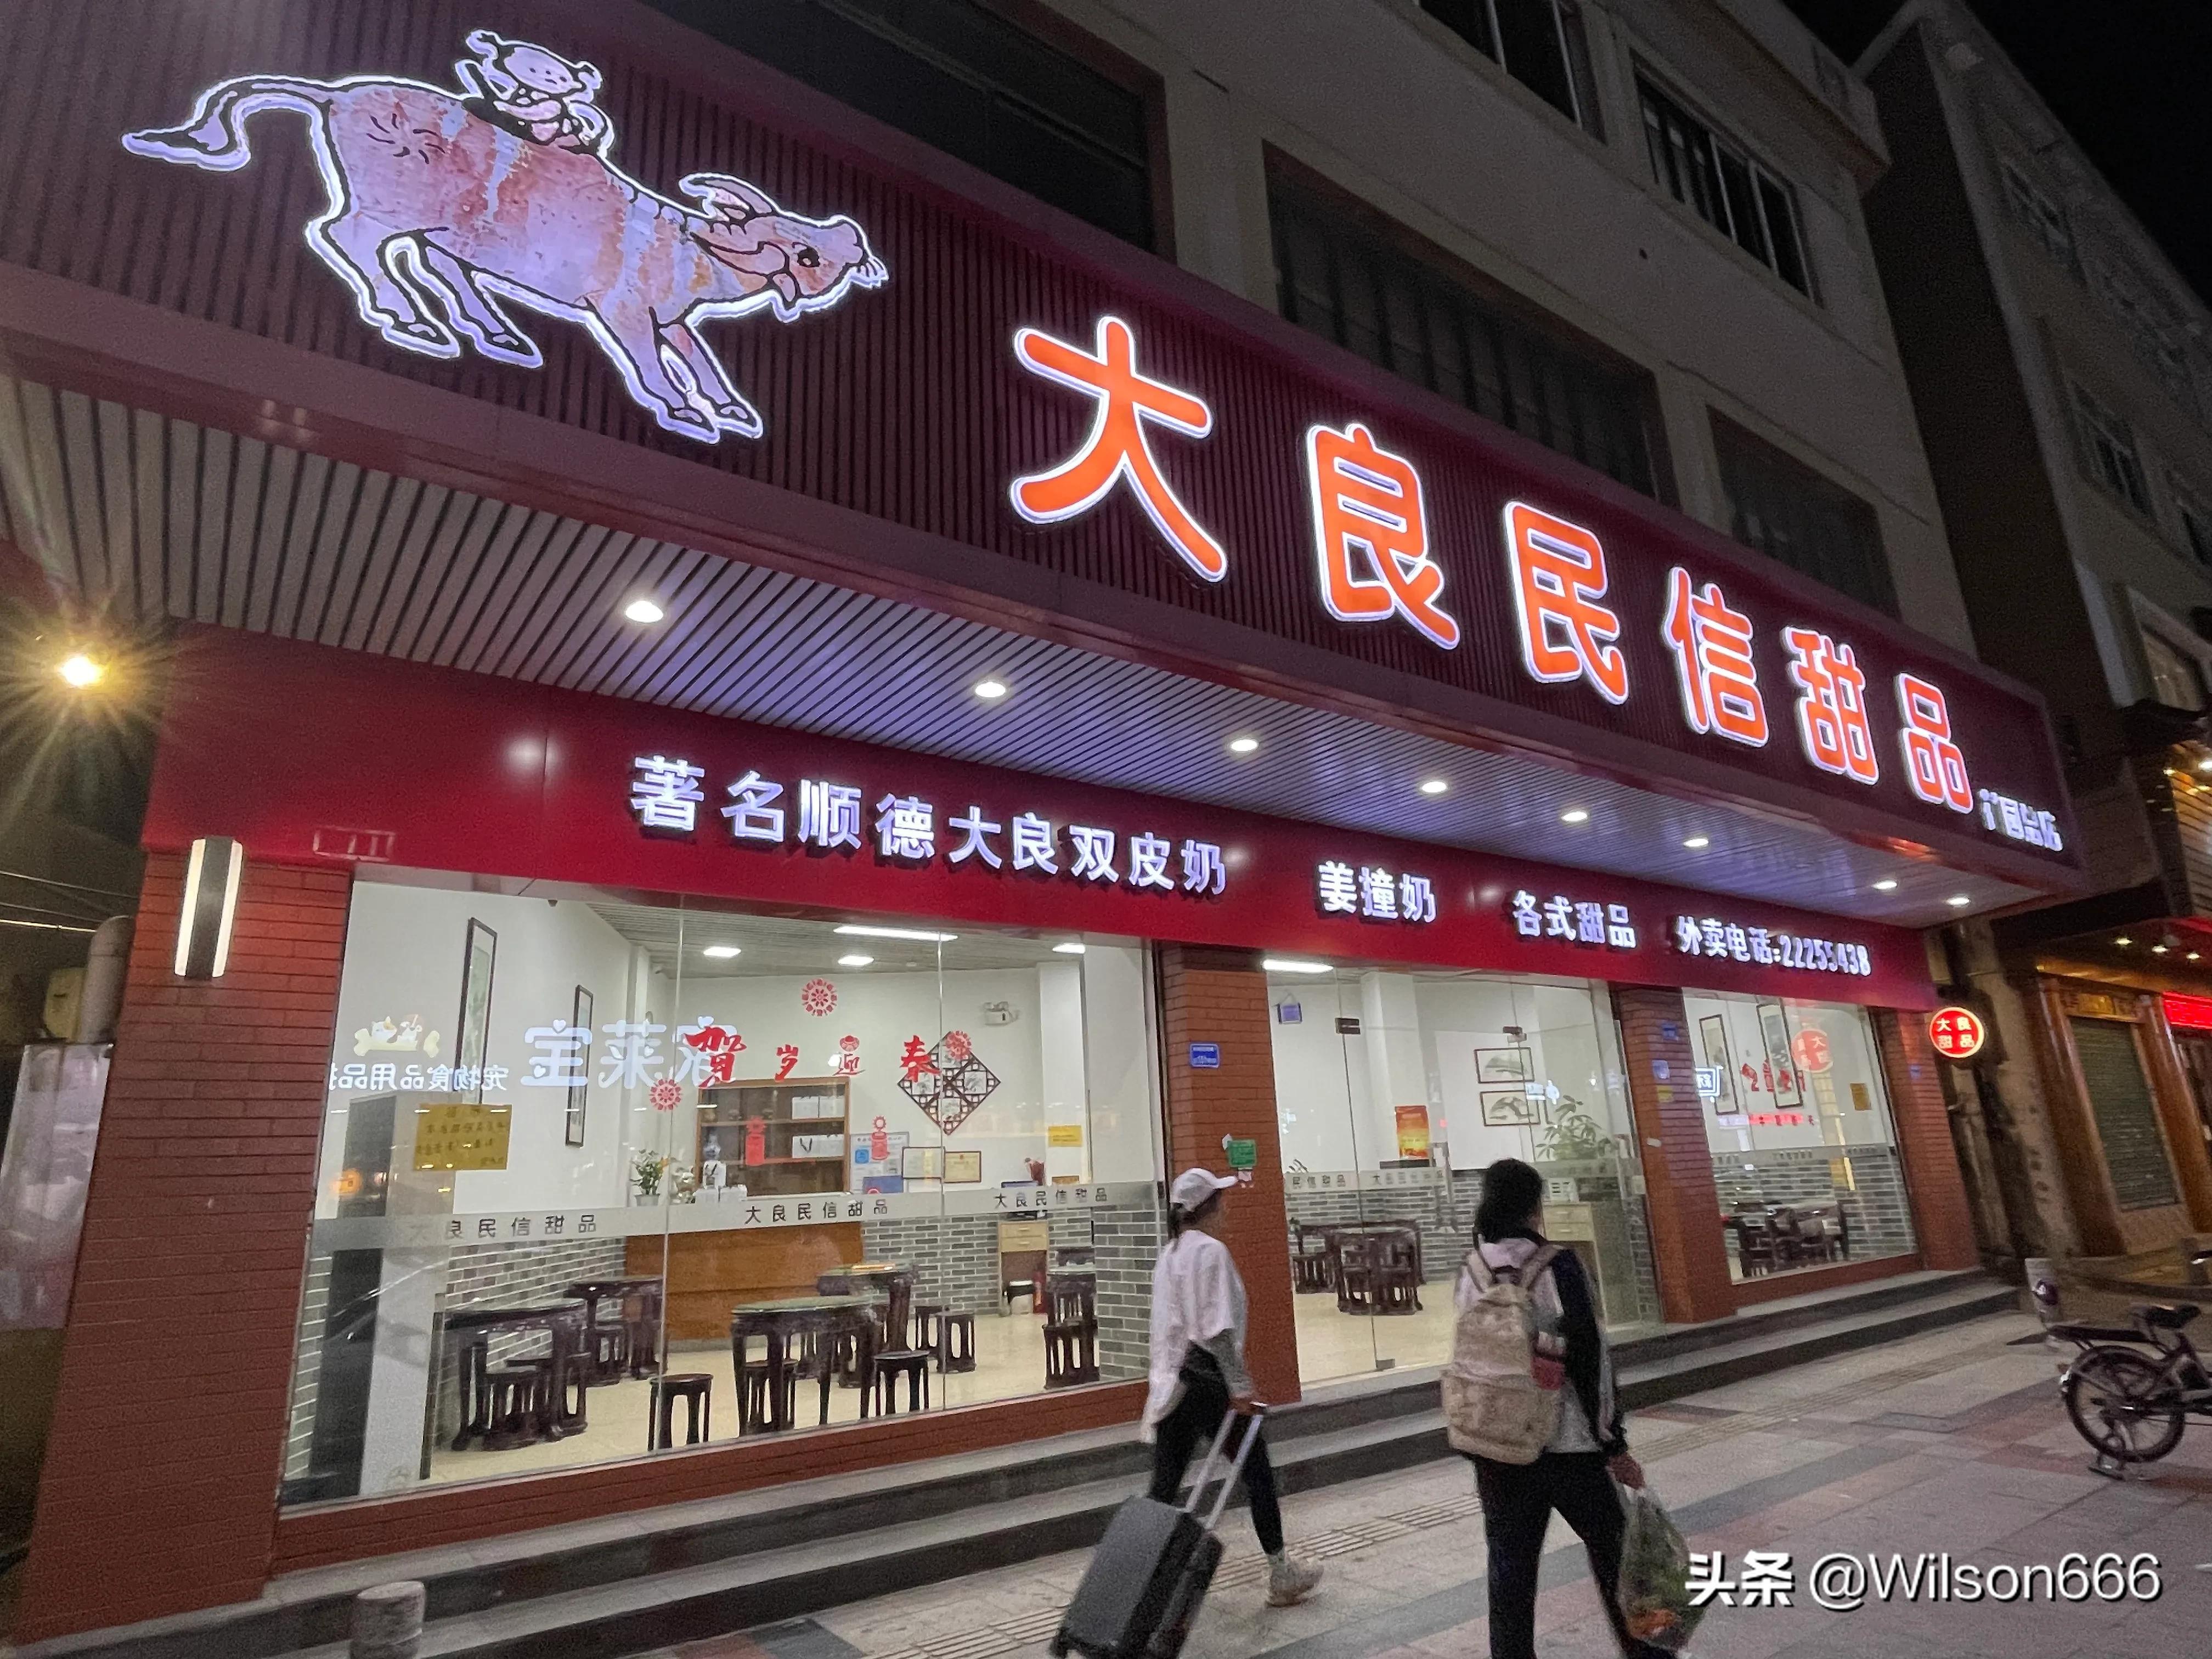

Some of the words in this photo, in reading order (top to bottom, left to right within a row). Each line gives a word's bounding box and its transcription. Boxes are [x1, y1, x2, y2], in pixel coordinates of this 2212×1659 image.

[1009, 315, 1974, 814] 大良民信甜品
[630, 754, 1228, 895] 著名顺德大良双皮奶
[1317, 861, 1437, 924] 姜撞奶
[1511, 890, 1637, 949] 各式甜品
[685, 1024, 941, 1088] 贺岁迎春
[744, 1198, 889, 1225] 大良民信甜品
[994, 1187, 1108, 1209] 大良民信甜品
